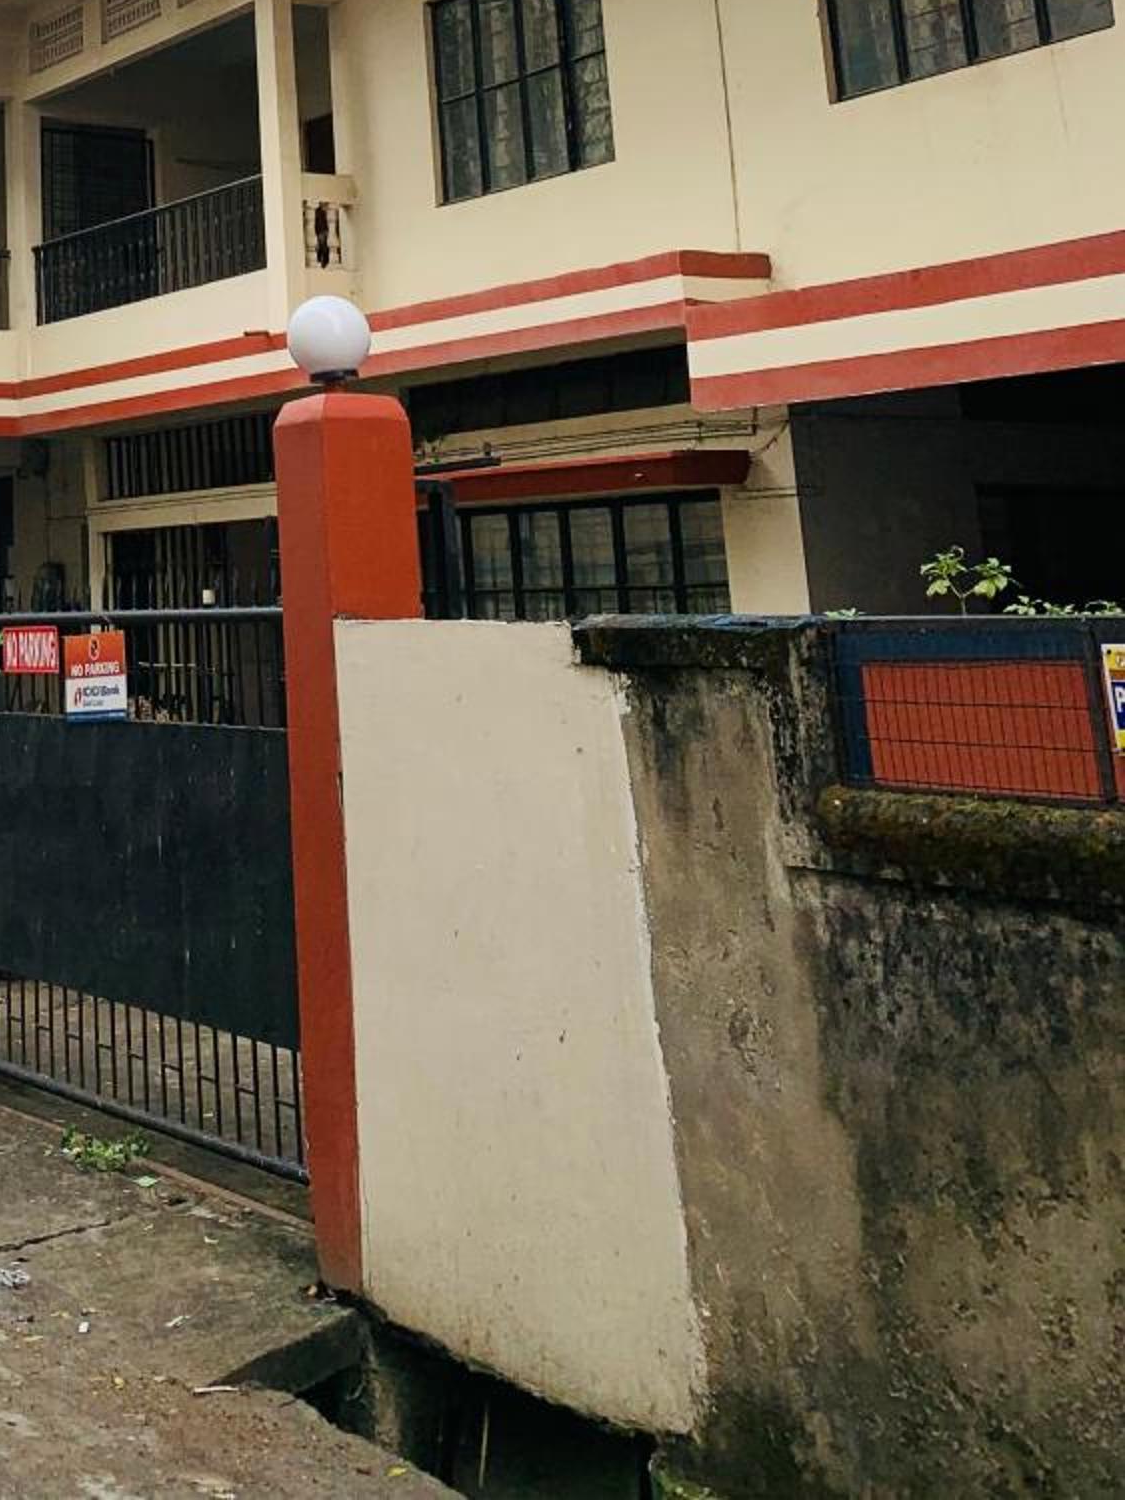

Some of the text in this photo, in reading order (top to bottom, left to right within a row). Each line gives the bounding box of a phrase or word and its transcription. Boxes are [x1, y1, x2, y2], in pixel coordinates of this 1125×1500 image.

[5, 631, 56, 668] NO PARKING
[71, 661, 120, 677] NO PARKING
